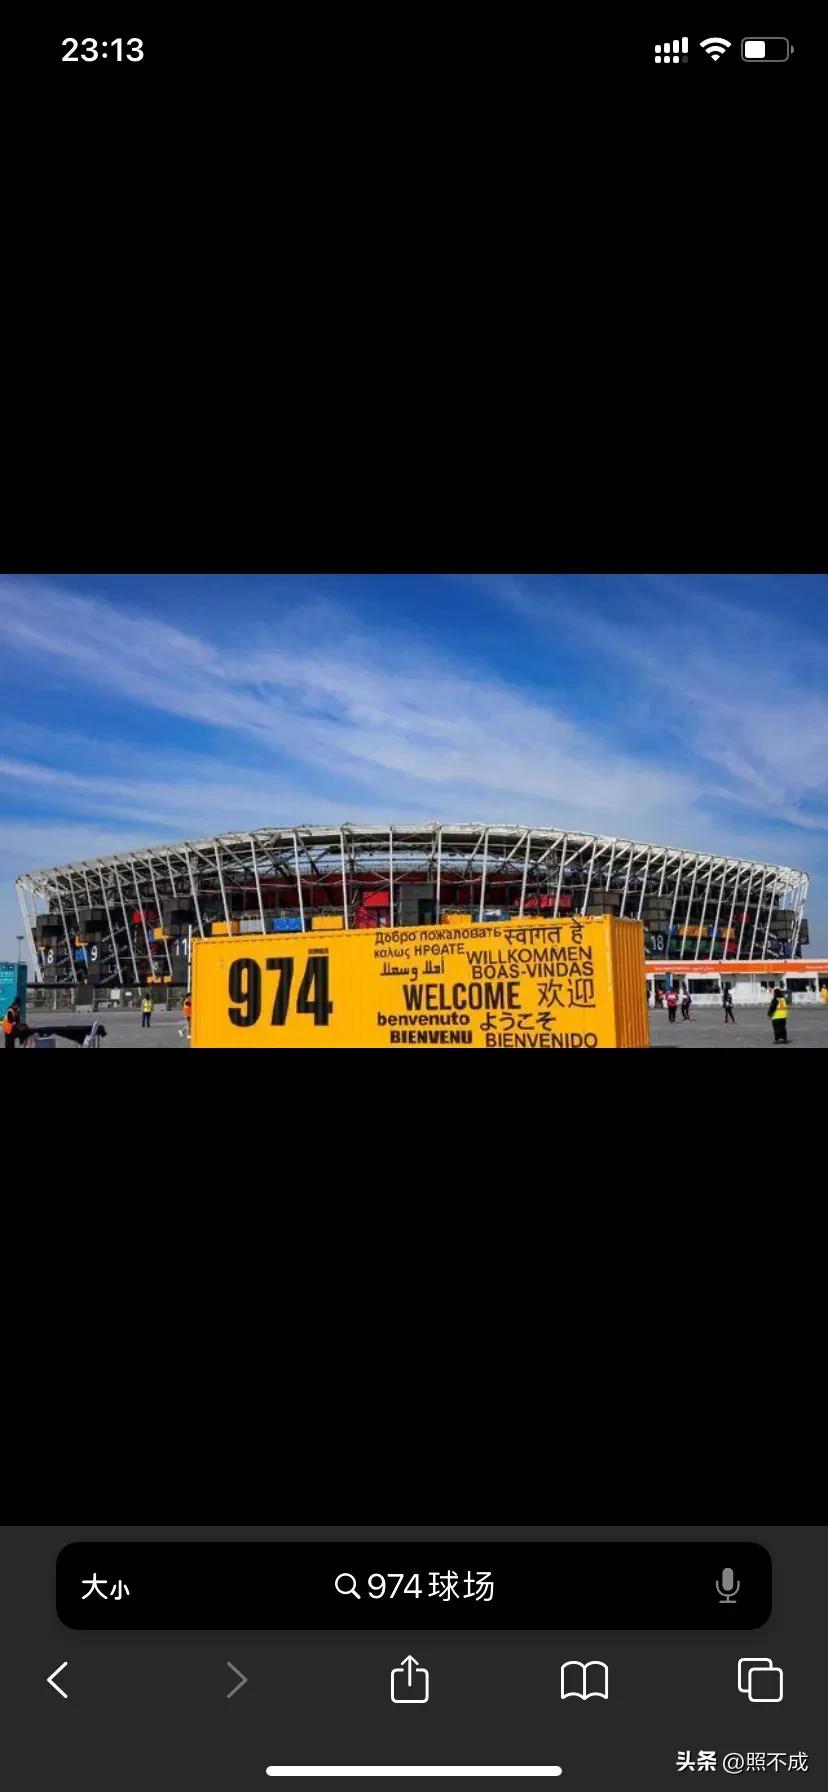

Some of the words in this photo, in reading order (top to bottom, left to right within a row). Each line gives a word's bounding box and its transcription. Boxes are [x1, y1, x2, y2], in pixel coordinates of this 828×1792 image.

[60, 37, 145, 63] 23:13
[374, 930, 416, 945] Добро
[419, 926, 502, 941] пожаловать
[651, 935, 665, 950] 18
[47, 949, 54, 964] 8
[91, 945, 98, 961] 9
[467, 946, 593, 965] WILLKOMMEN
[472, 961, 595, 980] BOAS-VINDAS
[228, 956, 334, 1027] 974
[402, 981, 522, 1011] WELCOME
[537, 978, 596, 1008] 欢迎
[377, 1012, 471, 1026] benvenuto
[480, 1011, 557, 1031] ようこそ
[390, 1030, 473, 1044] BIENVENU
[485, 1033, 598, 1048] BIENVENIDO
[81, 1572, 131, 1601] 大小
